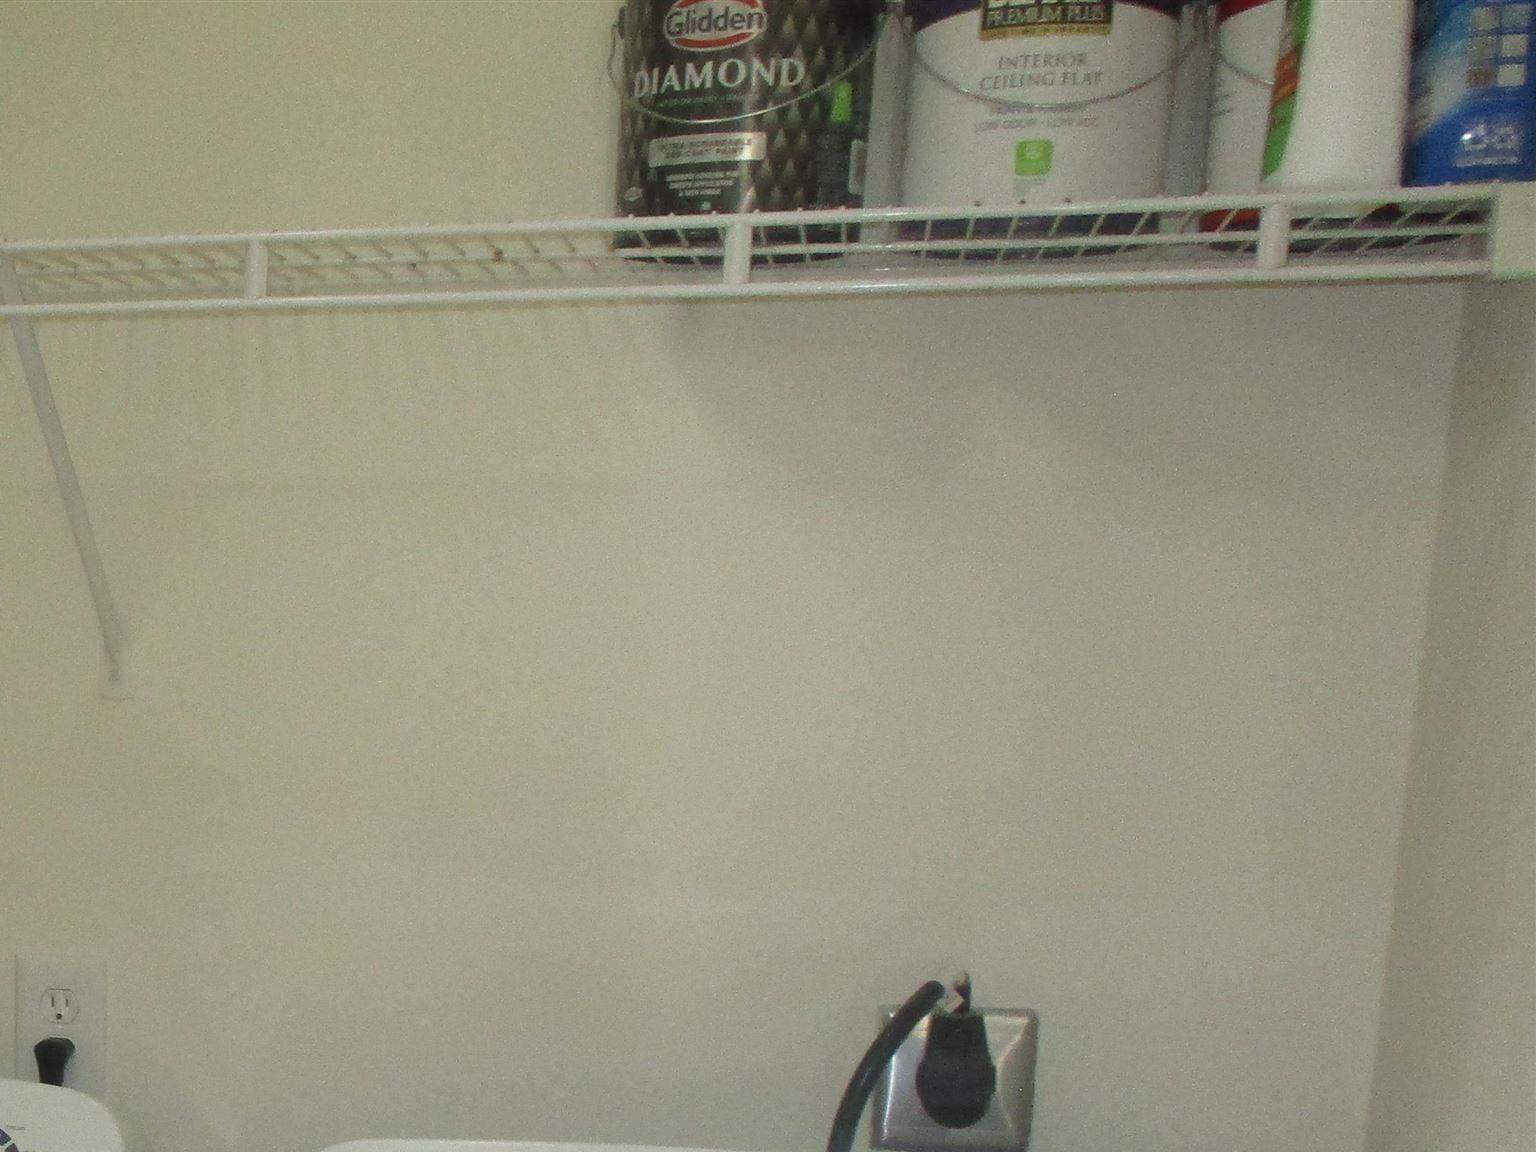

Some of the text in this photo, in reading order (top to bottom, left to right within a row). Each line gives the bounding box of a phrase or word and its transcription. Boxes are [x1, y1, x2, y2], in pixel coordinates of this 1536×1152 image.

[664, 8, 766, 37] Glidden
[997, 52, 1088, 70] INTERIOR
[633, 57, 807, 99] DIAMOND
[978, 71, 1055, 91] CEILING
